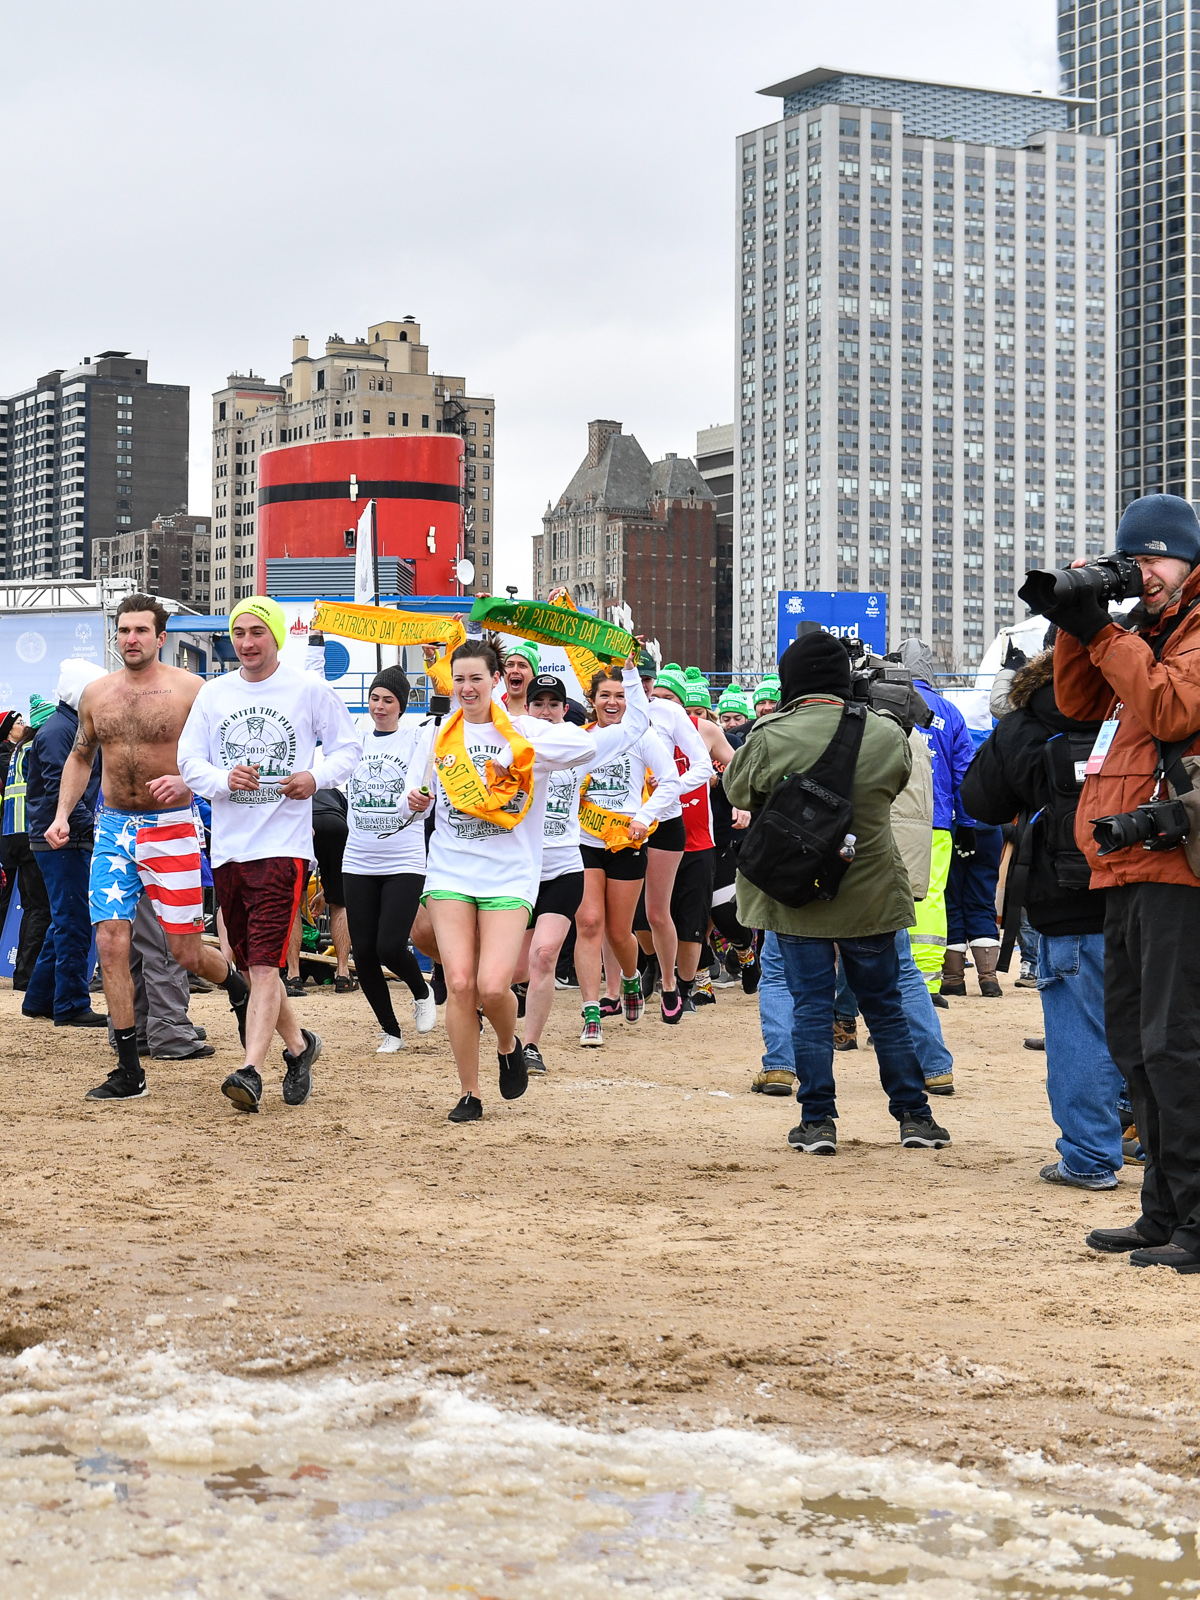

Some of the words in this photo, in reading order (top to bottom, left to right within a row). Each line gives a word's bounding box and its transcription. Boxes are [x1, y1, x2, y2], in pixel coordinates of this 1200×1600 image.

[317, 608, 330, 625] ST.
[333, 612, 377, 637] PATRICK'S
[379, 620, 397, 640] DAY
[401, 622, 429, 640] PARADE
[425, 620, 453, 638] COURT
[448, 630, 462, 646] 20
[512, 605, 526, 622] ST.
[529, 608, 579, 636] PATRICK'S
[578, 620, 602, 644] DAY
[538, 663, 566, 672] merica
[230, 706, 256, 720] WITH
[260, 706, 279, 719] THE
[278, 715, 297, 768] PLUMBERS
[246, 746, 265, 754] 2019
[445, 763, 470, 786] ST.
